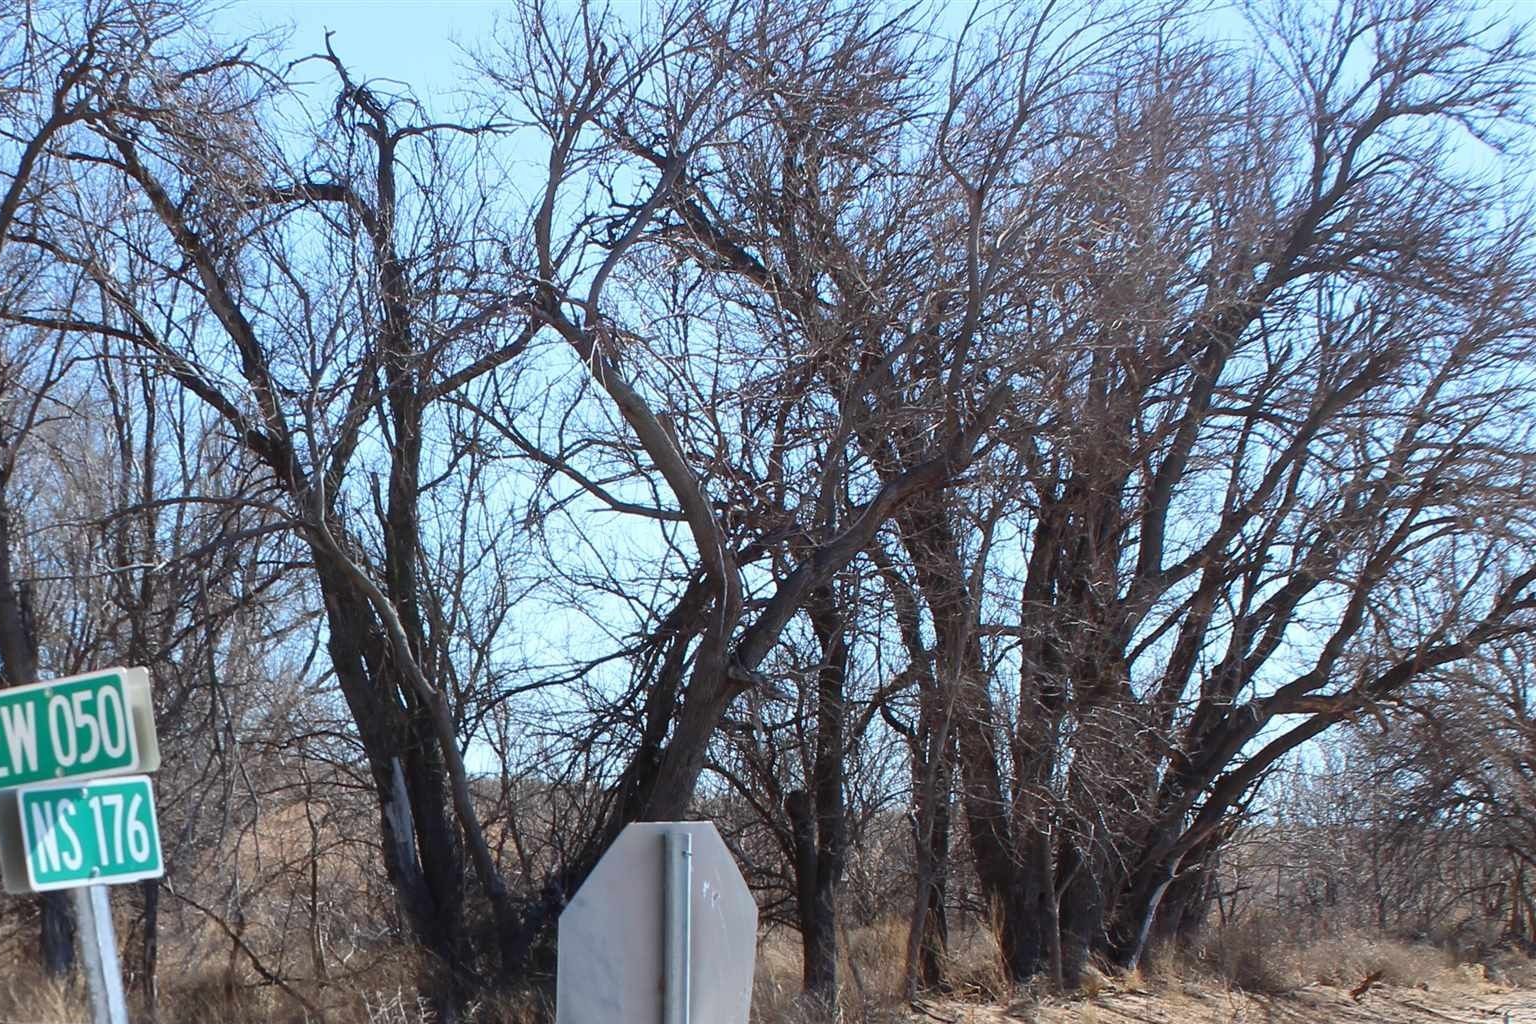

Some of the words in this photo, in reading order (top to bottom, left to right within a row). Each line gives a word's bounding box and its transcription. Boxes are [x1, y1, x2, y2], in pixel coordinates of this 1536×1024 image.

[48, 685, 126, 767] 050
[31, 798, 83, 873] NS
[89, 793, 150, 866] 176
